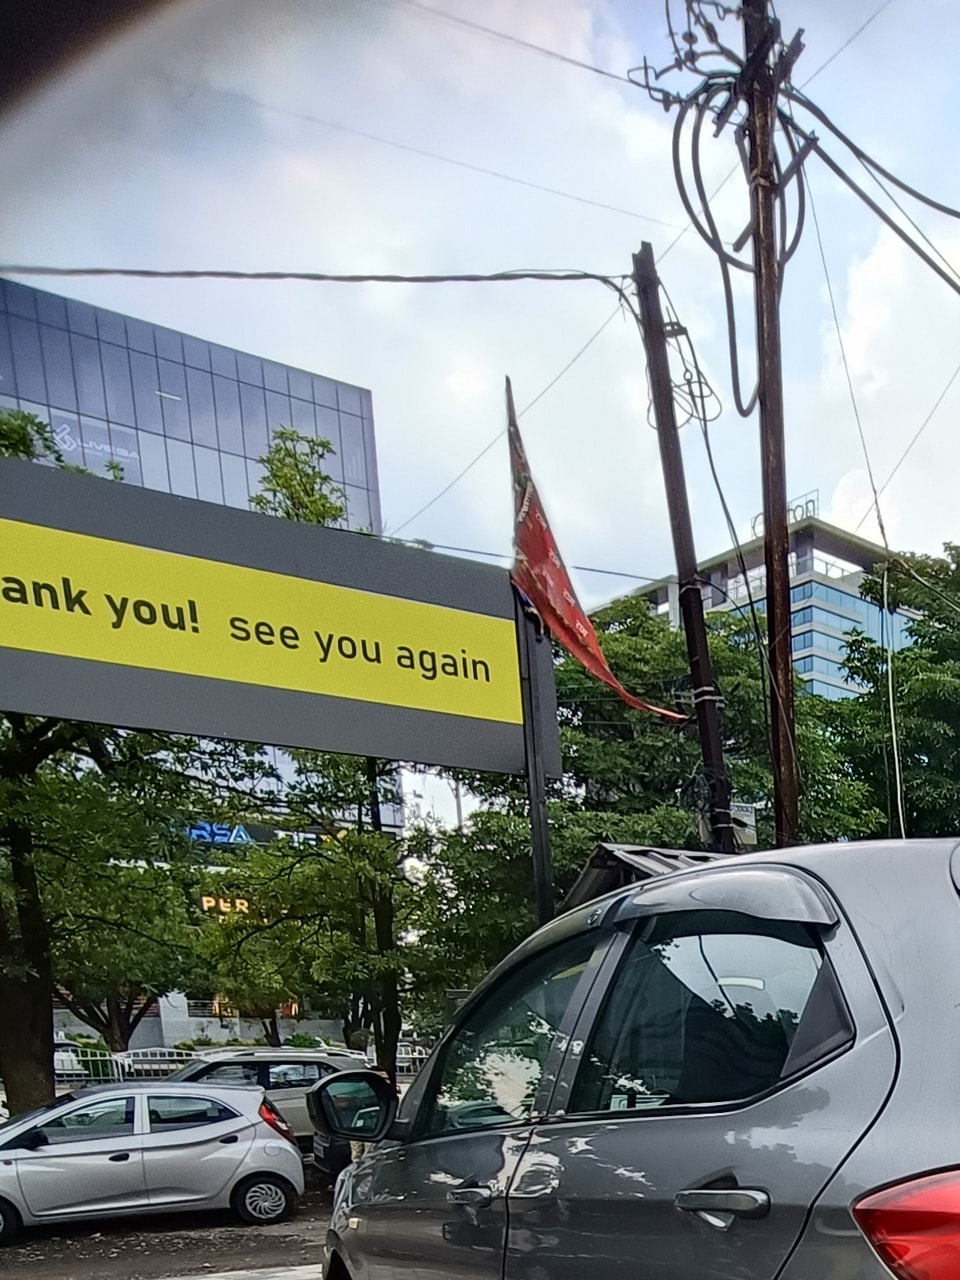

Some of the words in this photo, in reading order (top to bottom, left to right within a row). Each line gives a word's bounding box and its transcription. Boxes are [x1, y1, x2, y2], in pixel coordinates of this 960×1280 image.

[1, 576, 92, 616] ank
[104, 593, 200, 634] you!
[229, 616, 300, 649] see
[314, 630, 382, 664] you
[396, 645, 490, 682] again
